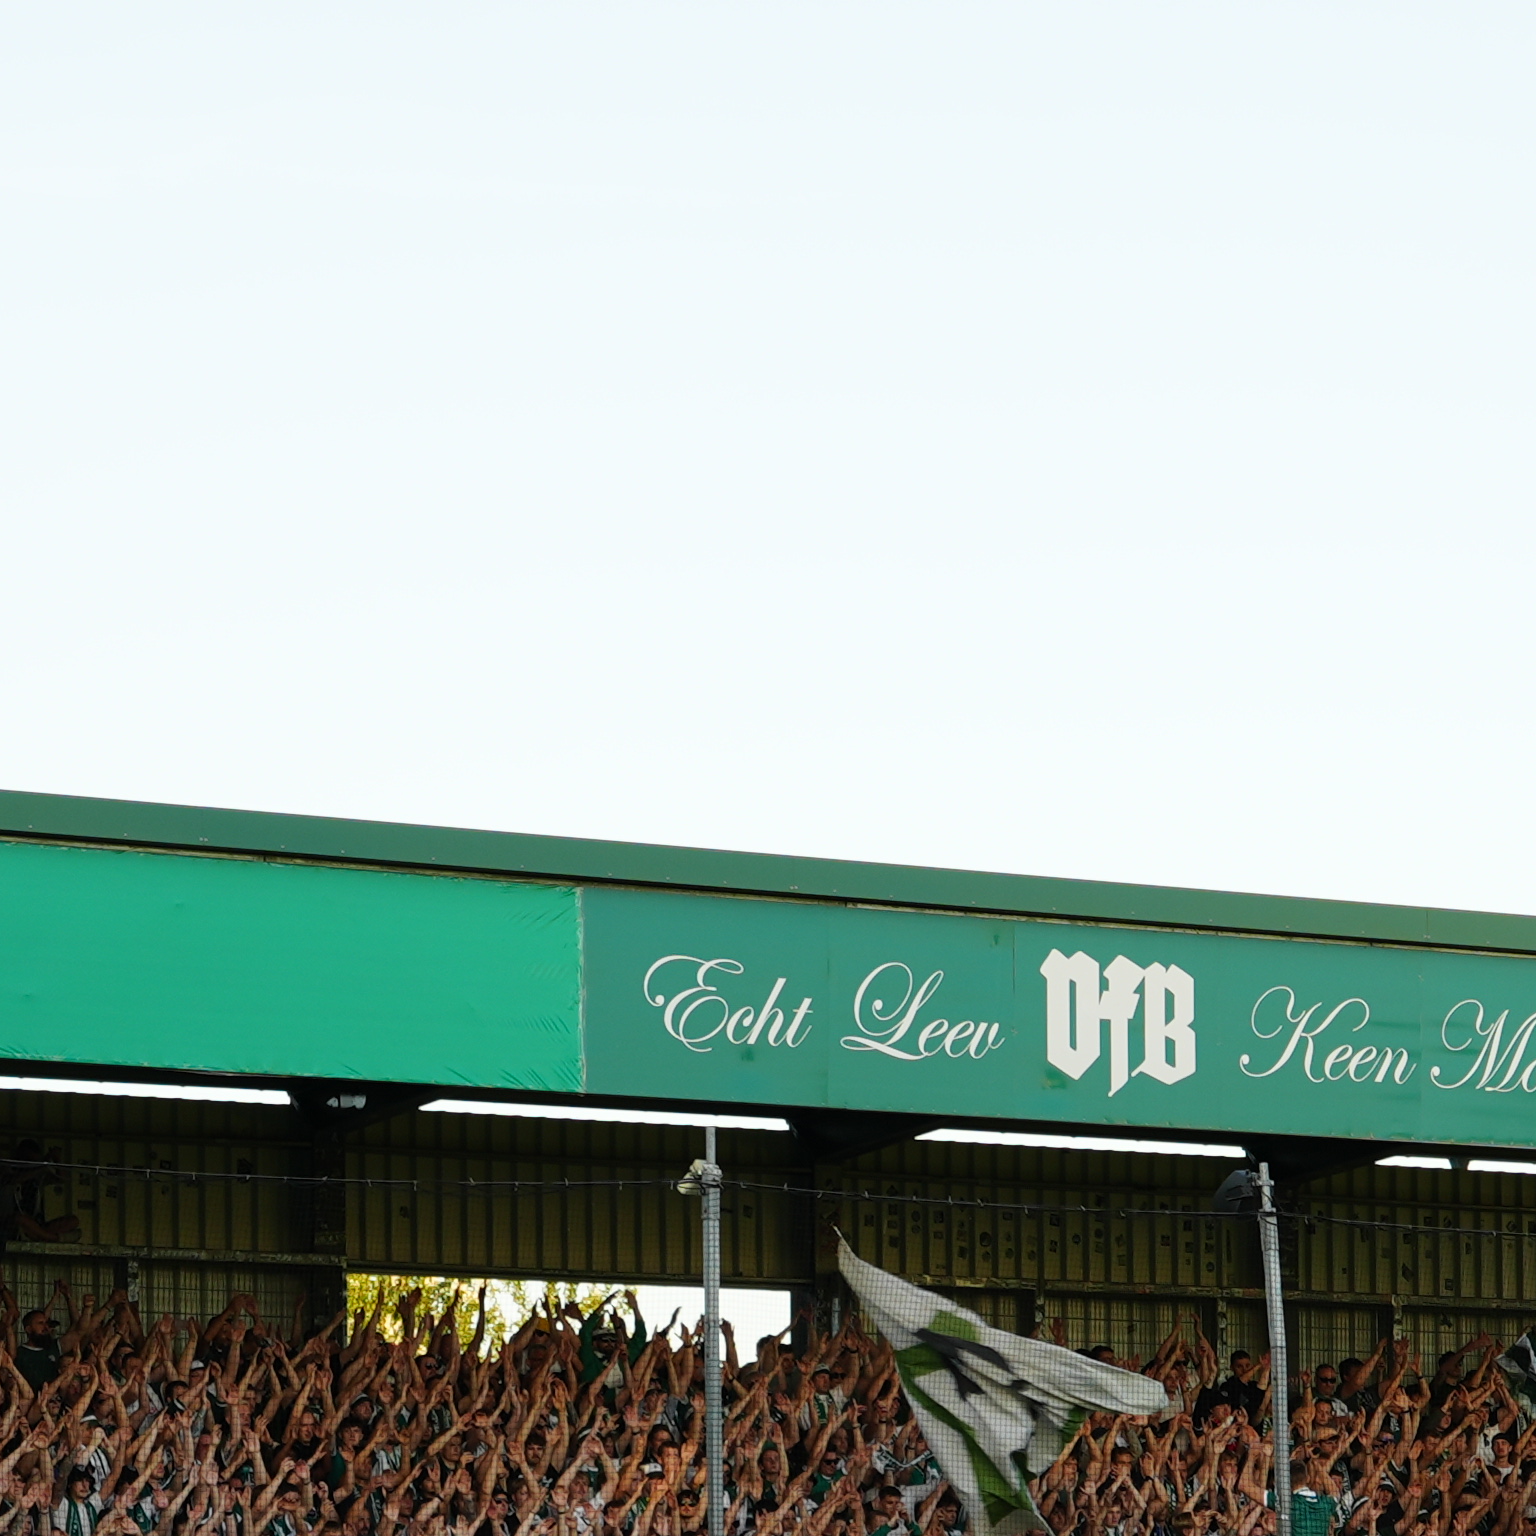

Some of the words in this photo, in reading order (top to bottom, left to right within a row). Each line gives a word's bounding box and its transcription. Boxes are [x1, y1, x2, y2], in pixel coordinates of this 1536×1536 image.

[643, 954, 814, 1053] Echt
[840, 961, 1006, 1061] Leev
[1239, 985, 1418, 1085] Keen
